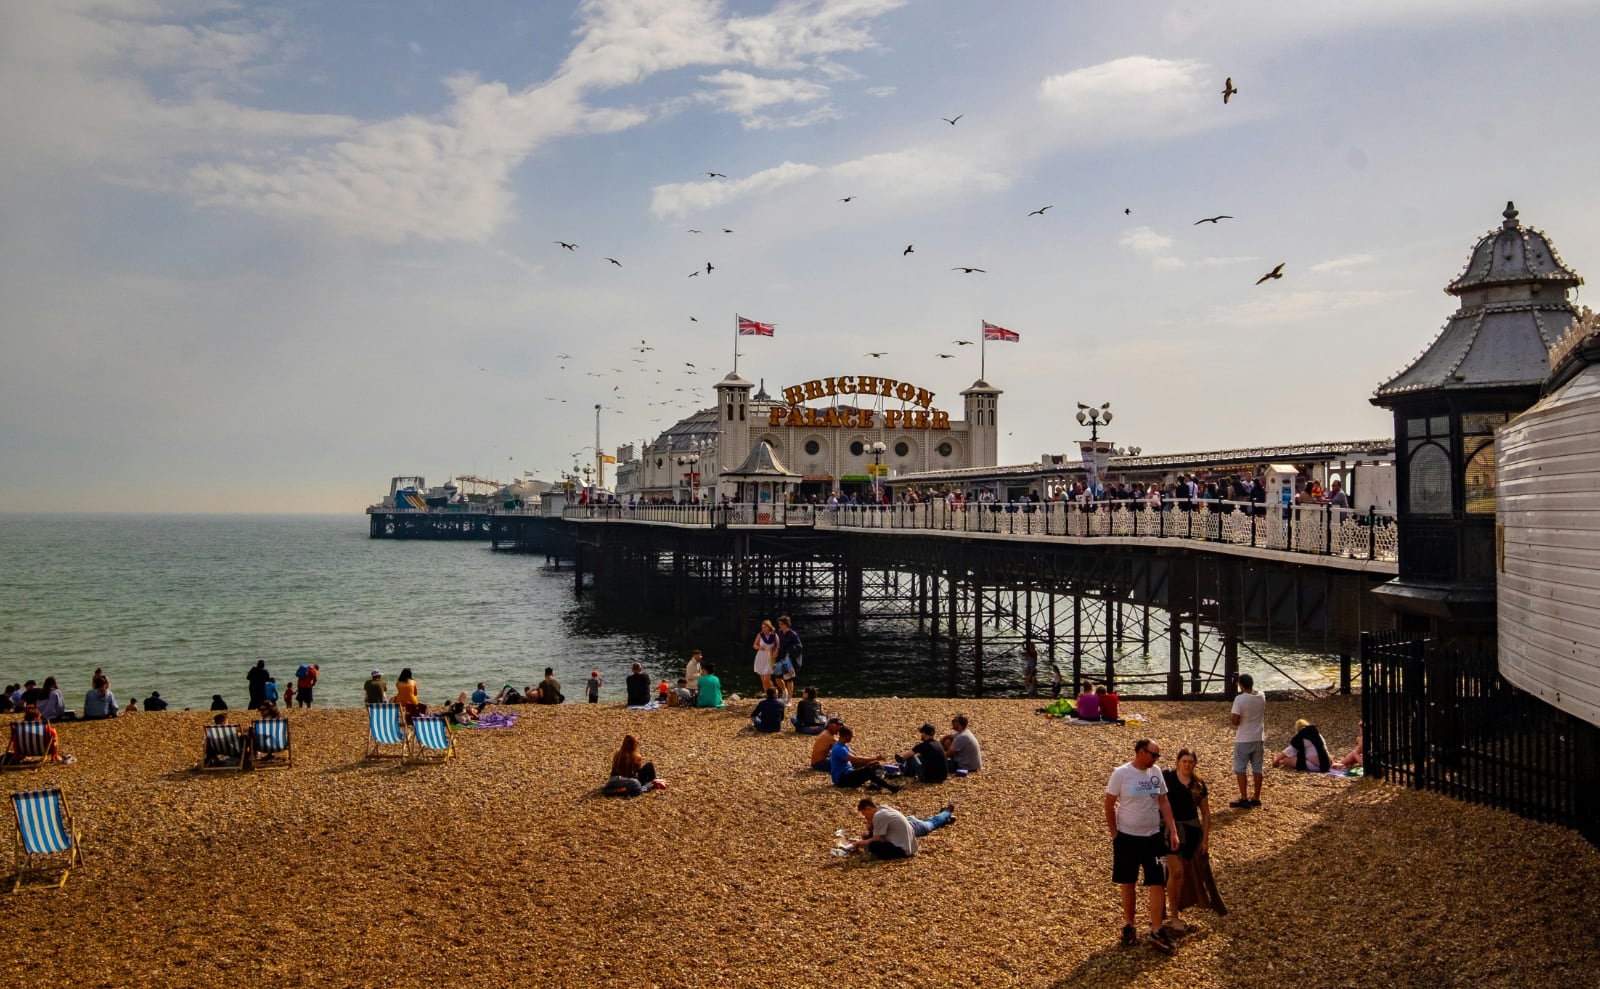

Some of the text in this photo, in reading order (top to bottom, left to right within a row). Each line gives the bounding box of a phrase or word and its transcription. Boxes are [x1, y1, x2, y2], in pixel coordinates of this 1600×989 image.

[783, 376, 935, 409] BRIGHTON
[769, 406, 950, 430] PALACE PIER
